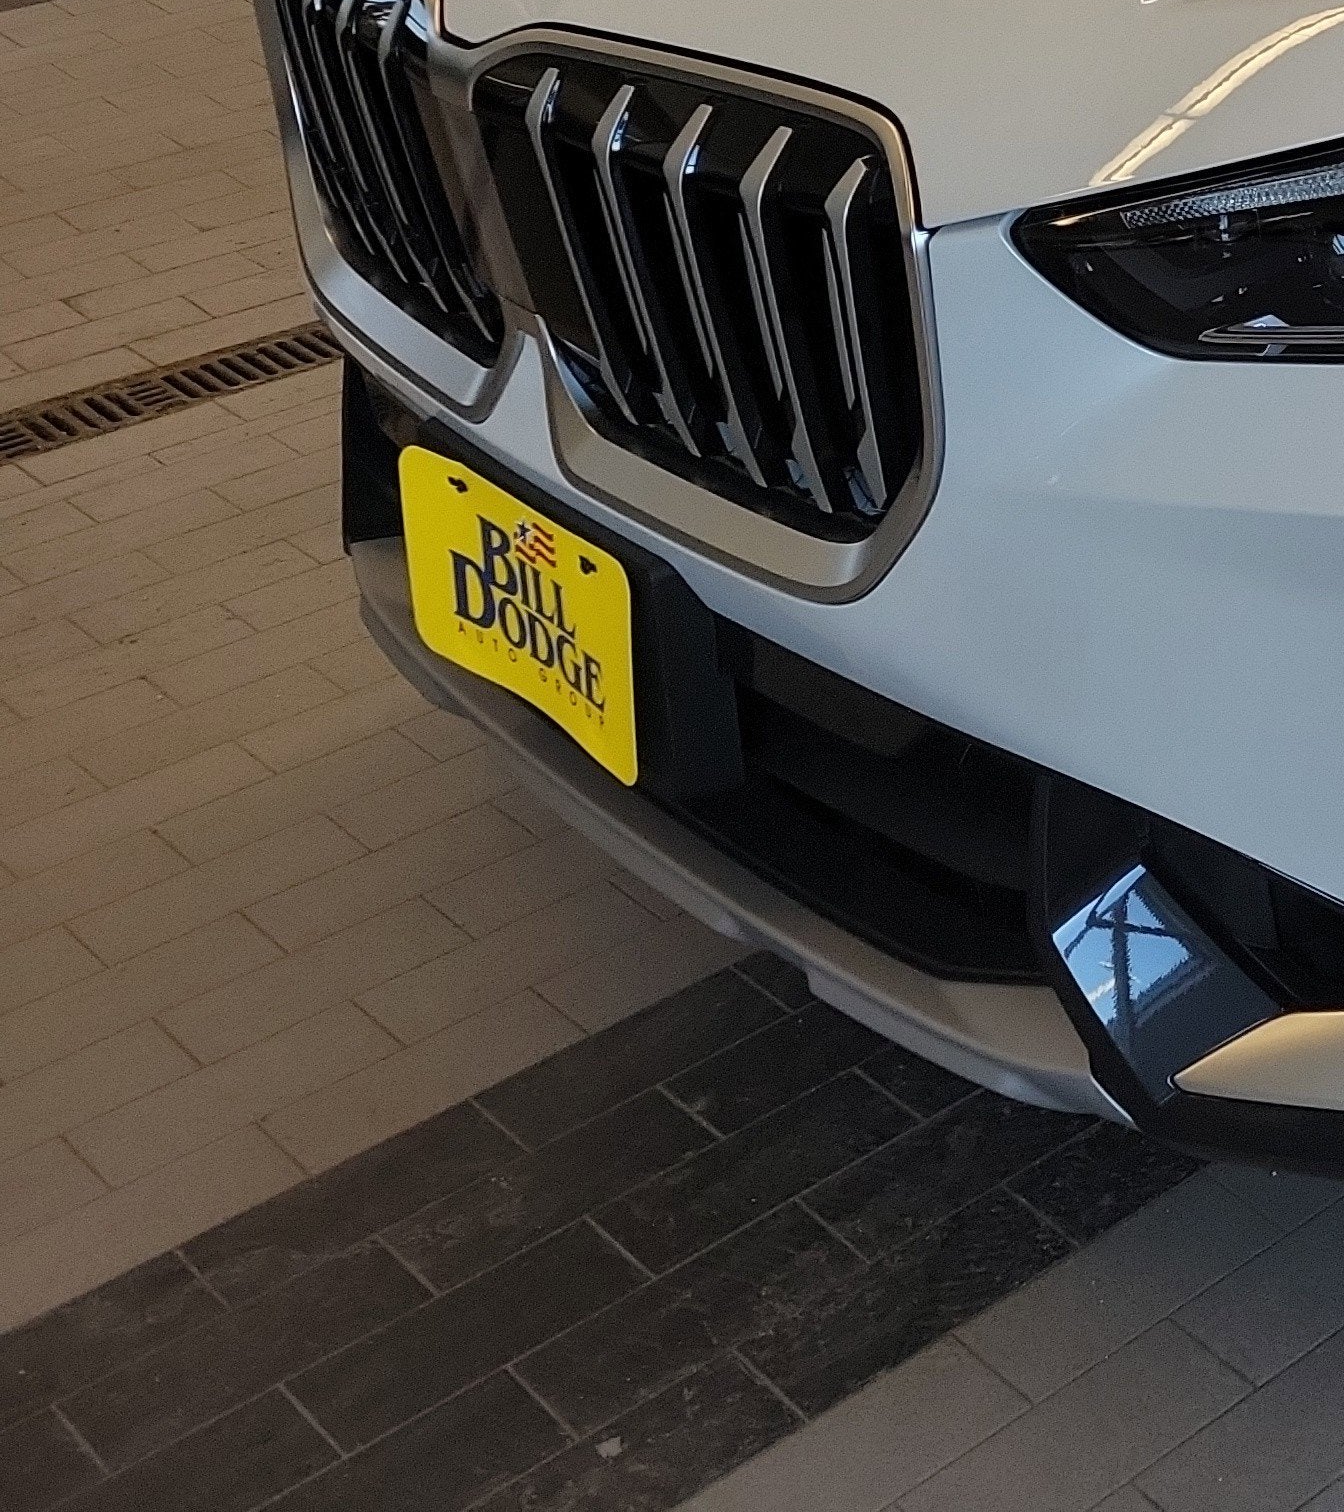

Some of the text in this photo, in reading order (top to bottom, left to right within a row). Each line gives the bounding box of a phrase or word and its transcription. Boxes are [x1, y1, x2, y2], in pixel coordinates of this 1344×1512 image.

[448, 548, 607, 712] DODGE
[477, 515, 577, 638] BILL
[457, 621, 607, 727] AUTO GROUP
